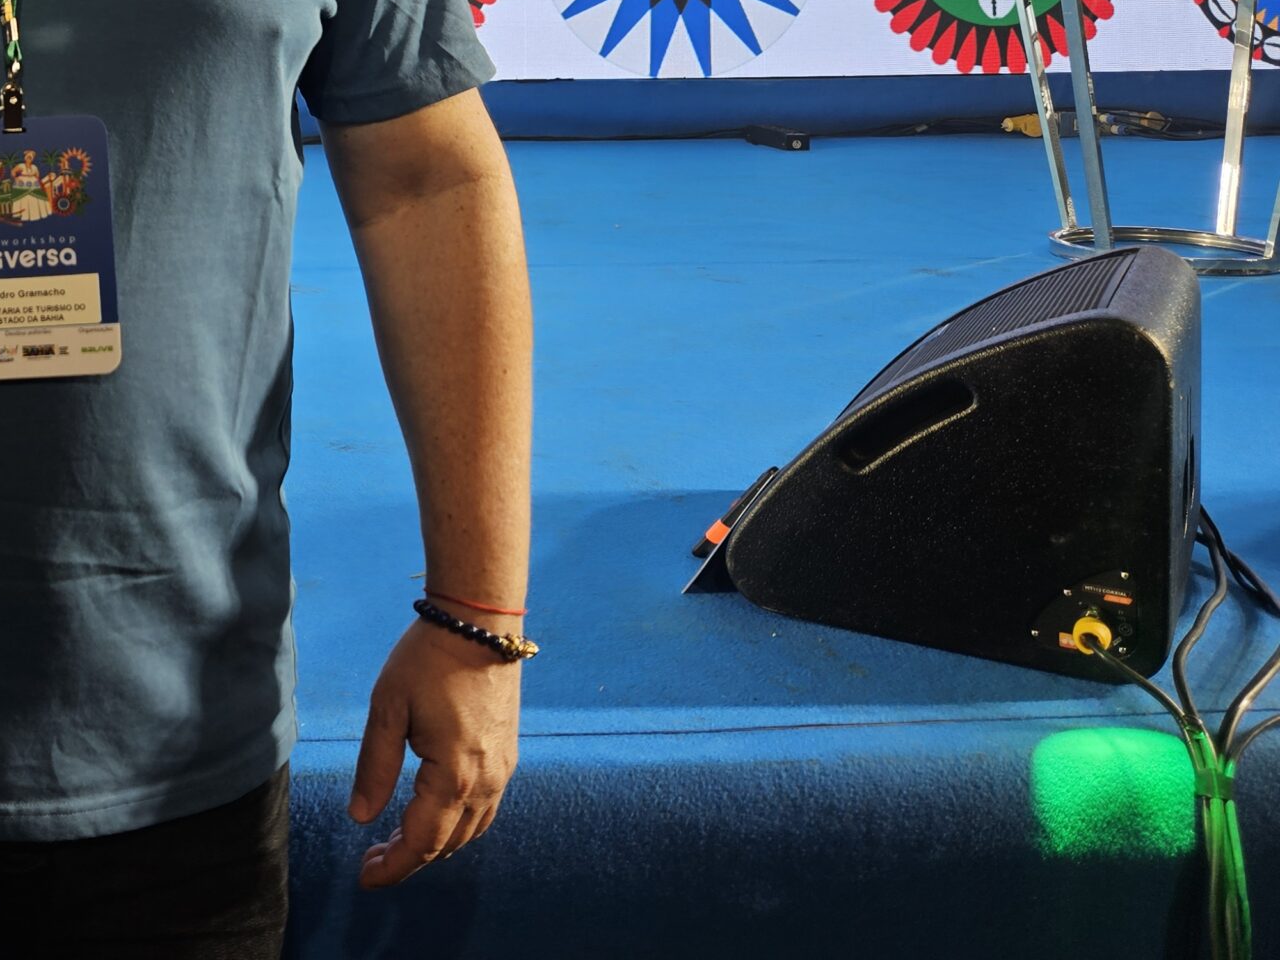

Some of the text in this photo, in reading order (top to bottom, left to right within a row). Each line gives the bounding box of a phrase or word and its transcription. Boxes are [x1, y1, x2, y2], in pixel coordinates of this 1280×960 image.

[0, 235, 77, 246] workshop
[17, 287, 66, 298] Gramacho
[36, 304, 72, 313] TURISMO
[74, 303, 86, 311] DO
